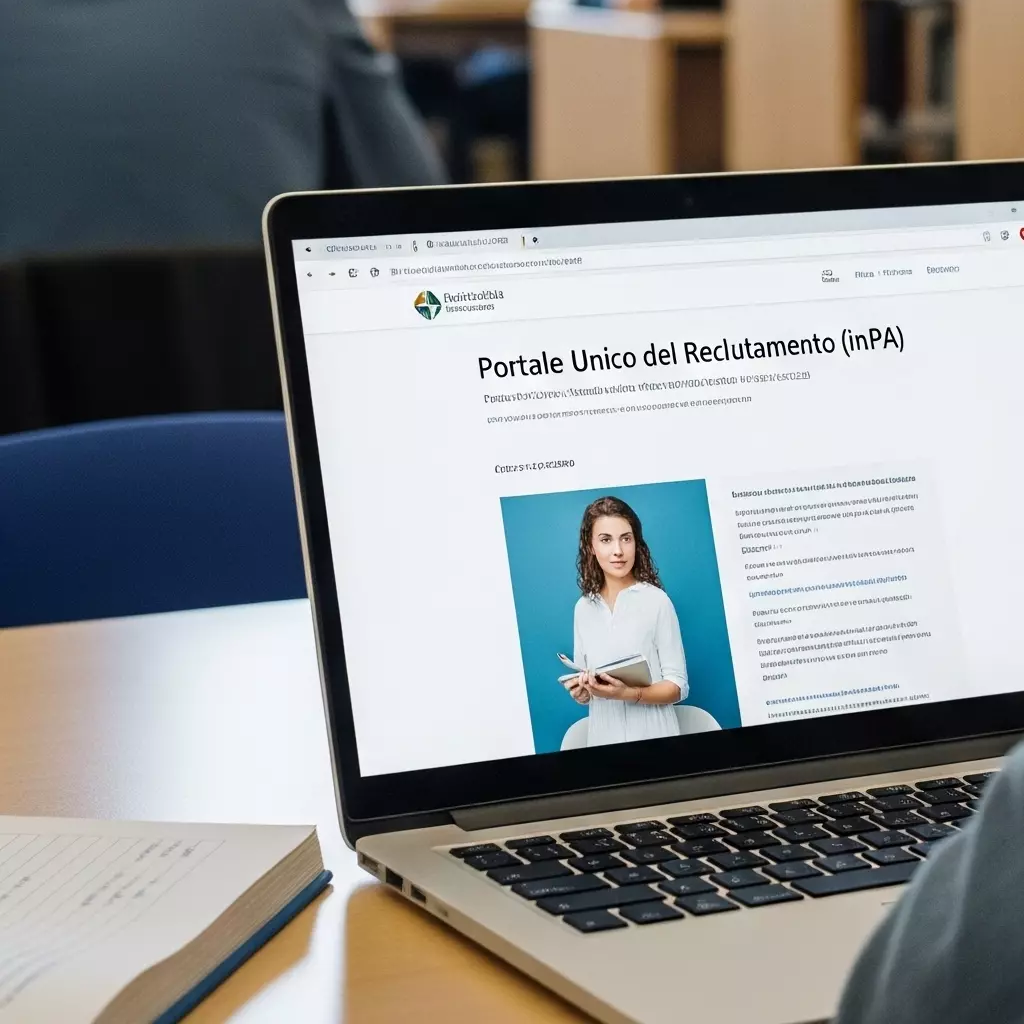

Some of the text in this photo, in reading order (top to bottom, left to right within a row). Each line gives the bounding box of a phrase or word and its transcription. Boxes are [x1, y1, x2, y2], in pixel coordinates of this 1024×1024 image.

[478, 326, 904, 379] Portale Unico del Reclutamento (inPA)
